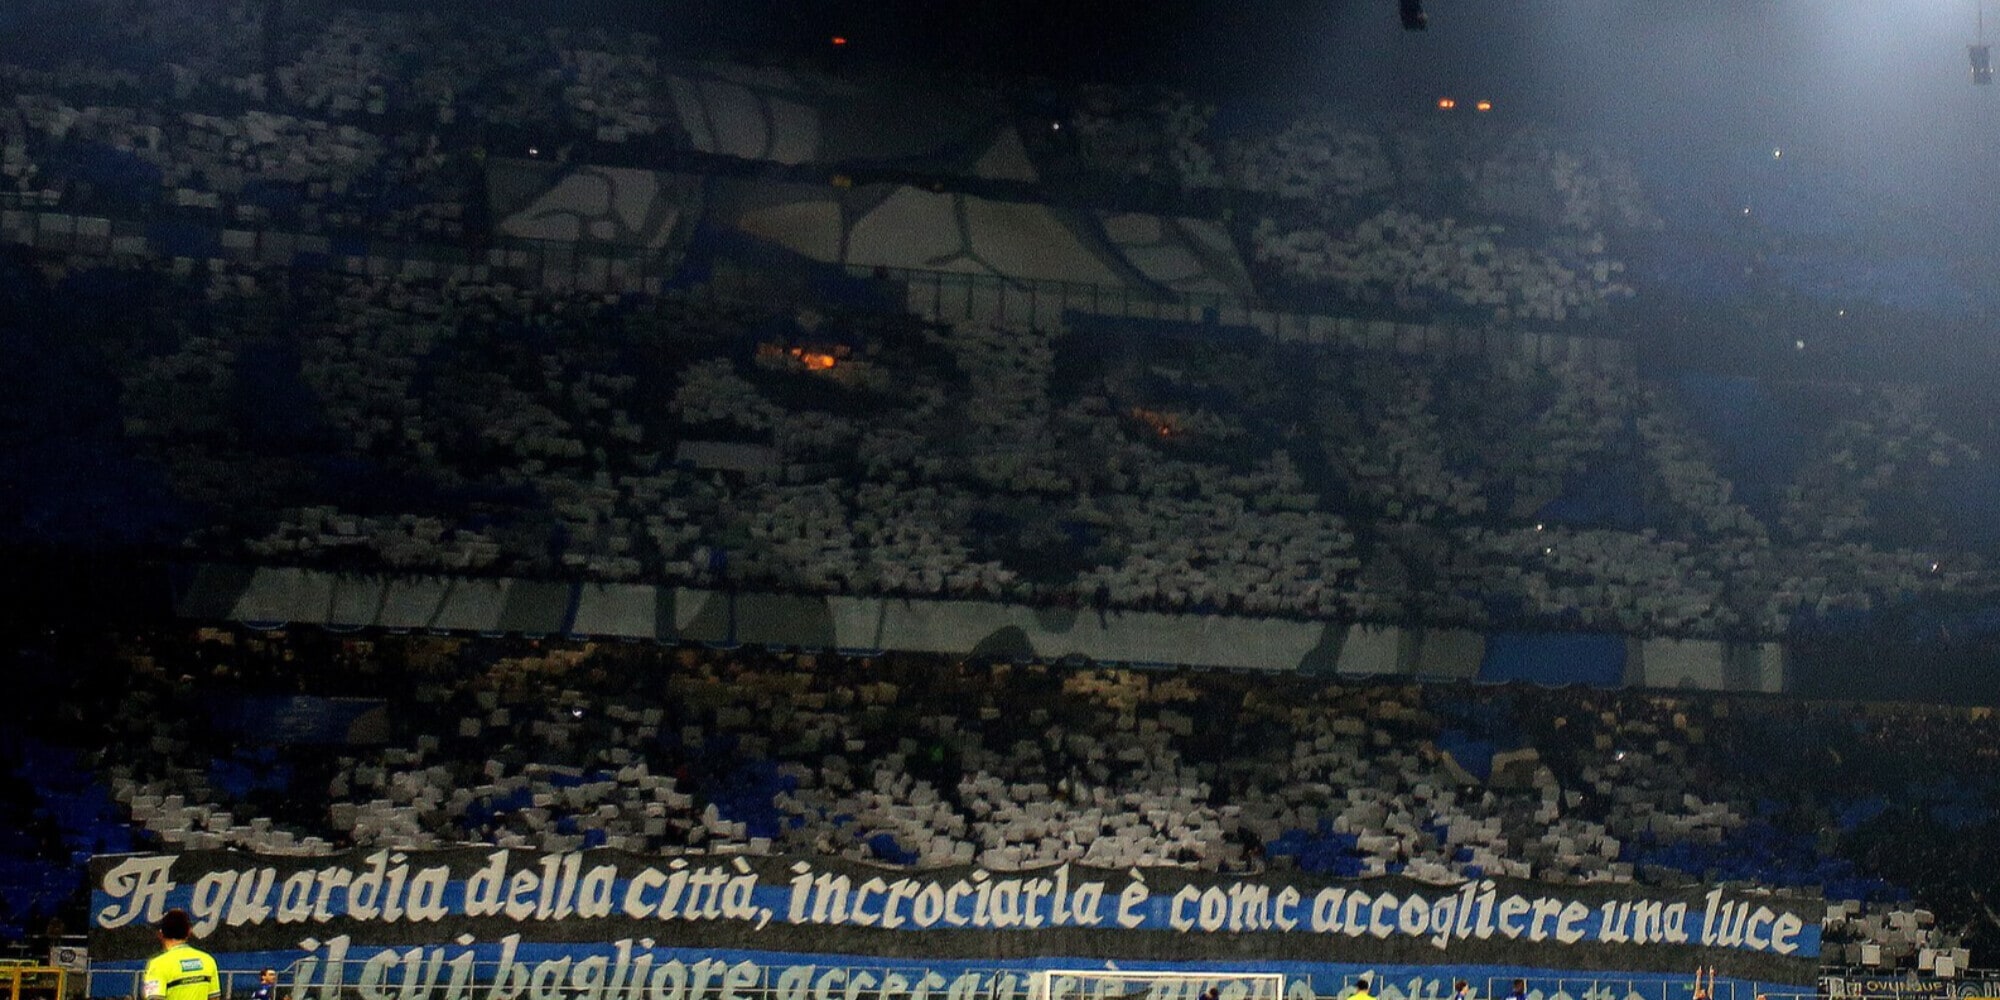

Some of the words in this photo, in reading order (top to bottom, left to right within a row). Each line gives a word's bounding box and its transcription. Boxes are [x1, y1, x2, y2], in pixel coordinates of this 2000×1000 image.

[192, 848, 449, 938] guardia
[465, 849, 617, 921] della
[623, 856, 772, 931] città,
[787, 860, 1105, 929] incrociarla
[1117, 866, 1149, 929] è
[1169, 882, 1301, 933] come
[1311, 879, 1591, 950] accogliere
[1599, 897, 1689, 945] una
[1700, 883, 1802, 955] luce
[293, 934, 351, 1000] il
[357, 933, 476, 1000] cui
[487, 932, 761, 1000] bagliore
